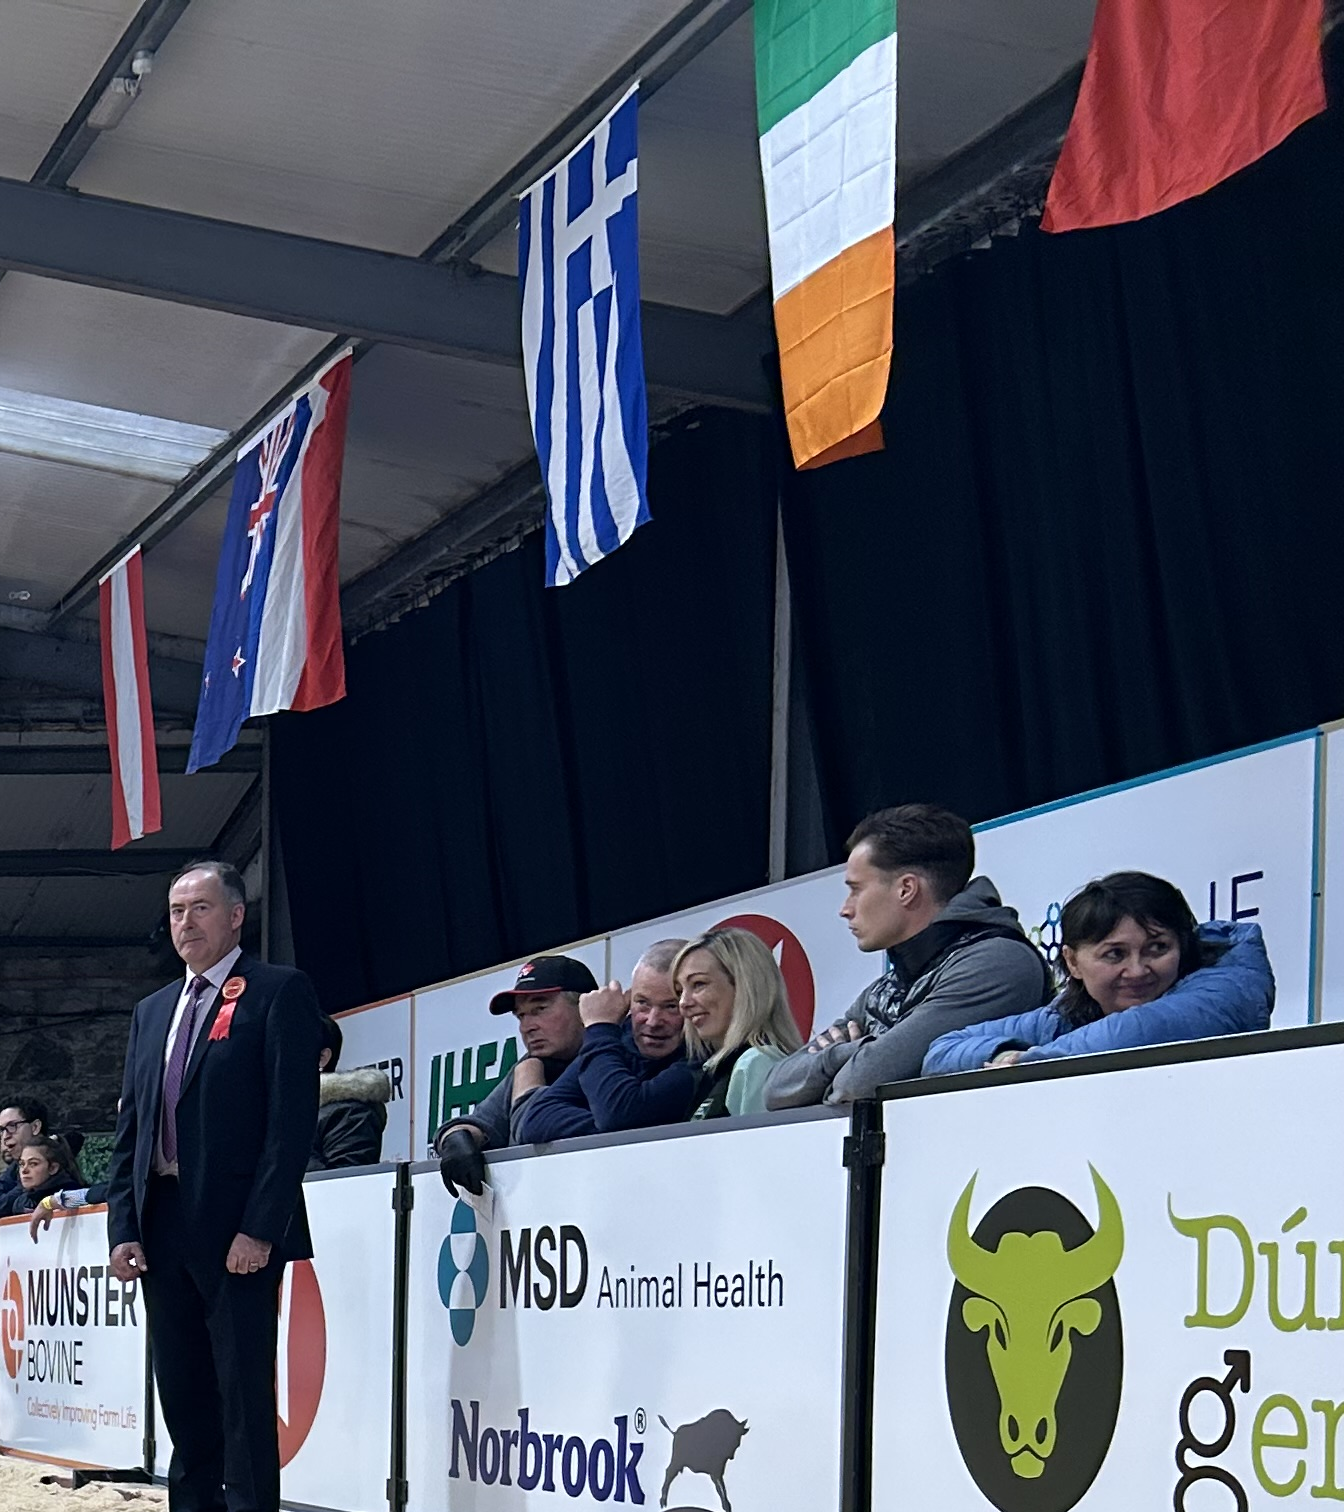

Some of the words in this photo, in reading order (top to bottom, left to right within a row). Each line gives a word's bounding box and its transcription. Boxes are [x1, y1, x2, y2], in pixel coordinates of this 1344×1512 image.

[499, 1224, 589, 1311] MSD
[596, 1262, 683, 1309] Animal
[693, 1259, 785, 1308] Health
[27, 1265, 138, 1328] MUNSTER
[27, 1339, 83, 1386] BOVINE
[98, 1403, 120, 1427] Farm
[120, 1405, 137, 1430] Life
